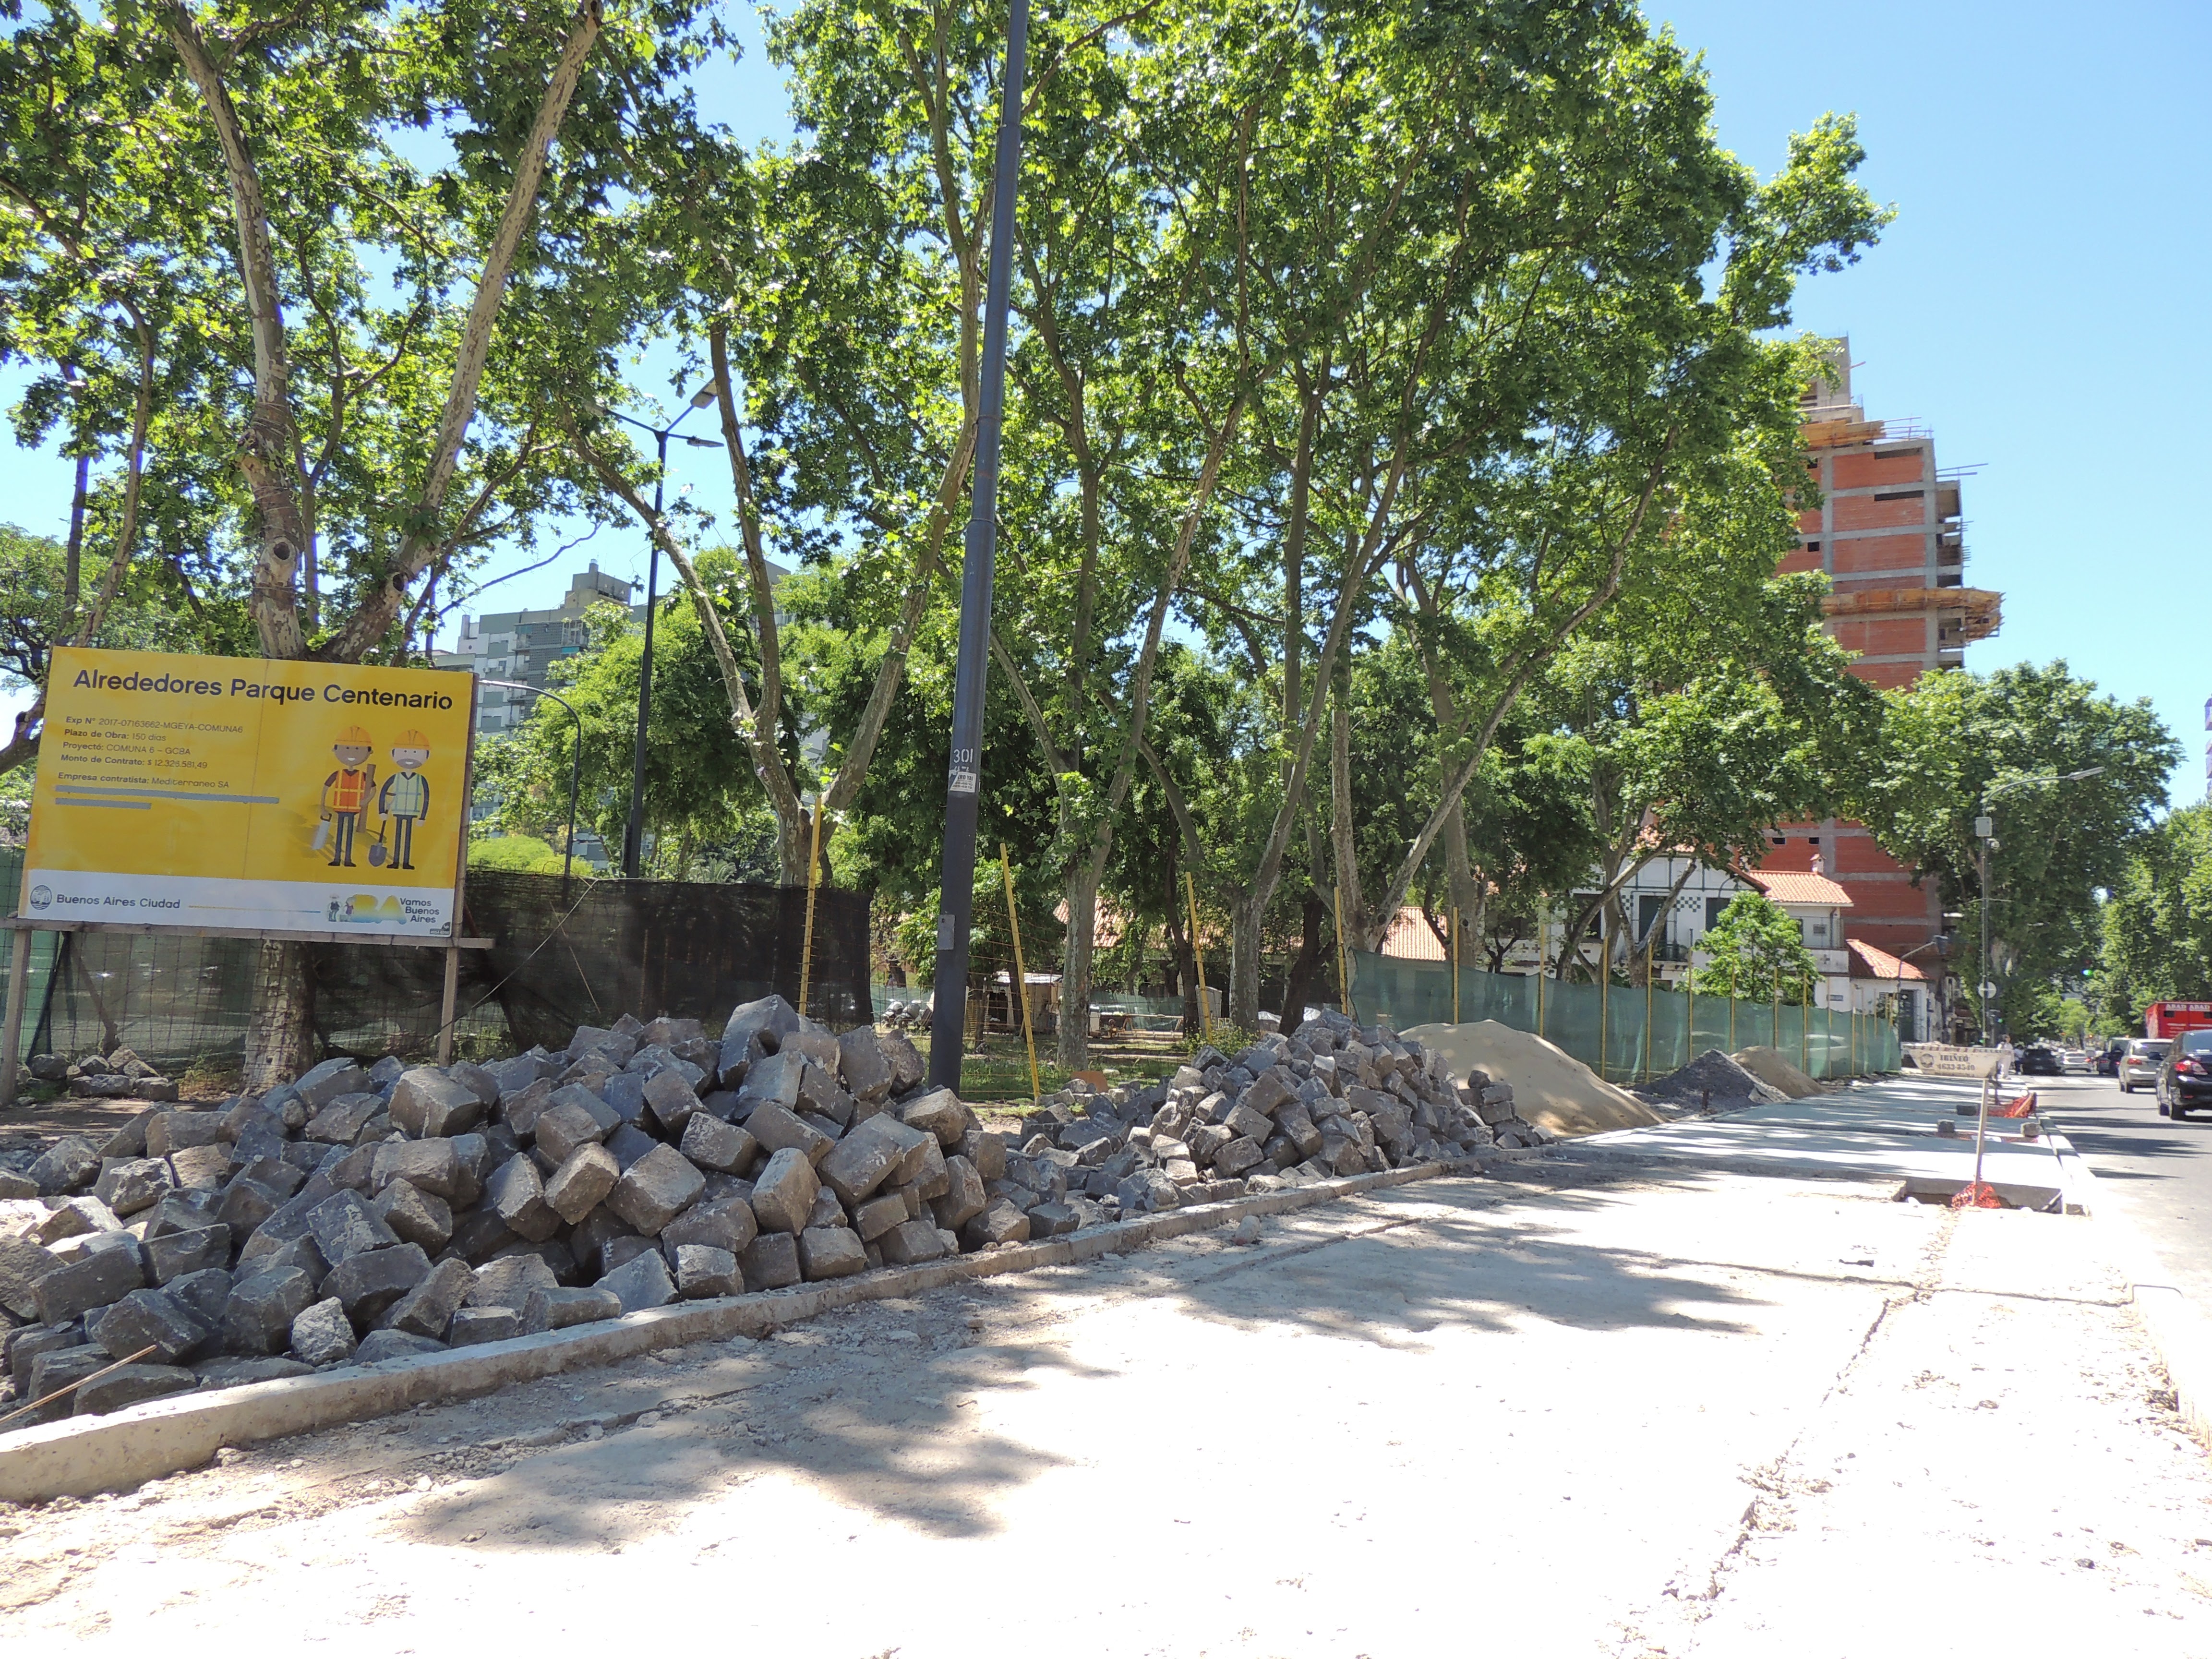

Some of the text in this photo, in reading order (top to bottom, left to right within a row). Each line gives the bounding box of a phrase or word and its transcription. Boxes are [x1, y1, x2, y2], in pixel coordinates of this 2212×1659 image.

[73, 669, 452, 710] Alrededores Parque Centenario
[65, 716, 82, 725] Exp
[64, 729, 87, 737] Plazo
[105, 731, 129, 739] Obra:
[106, 744, 146, 753] COMUNA
[60, 754, 87, 762] Monto
[104, 757, 144, 766] Contrato:
[953, 748, 974, 763] 301
[58, 772, 97, 781] Empresa
[100, 775, 149, 784] contratista:
[151, 777, 215, 787] Mediterraneo
[56, 894, 180, 909] Buenos Aires Ciudad
[399, 897, 432, 907] Vamos
[405, 906, 440, 915] Buenos
[410, 914, 436, 923] Aires
